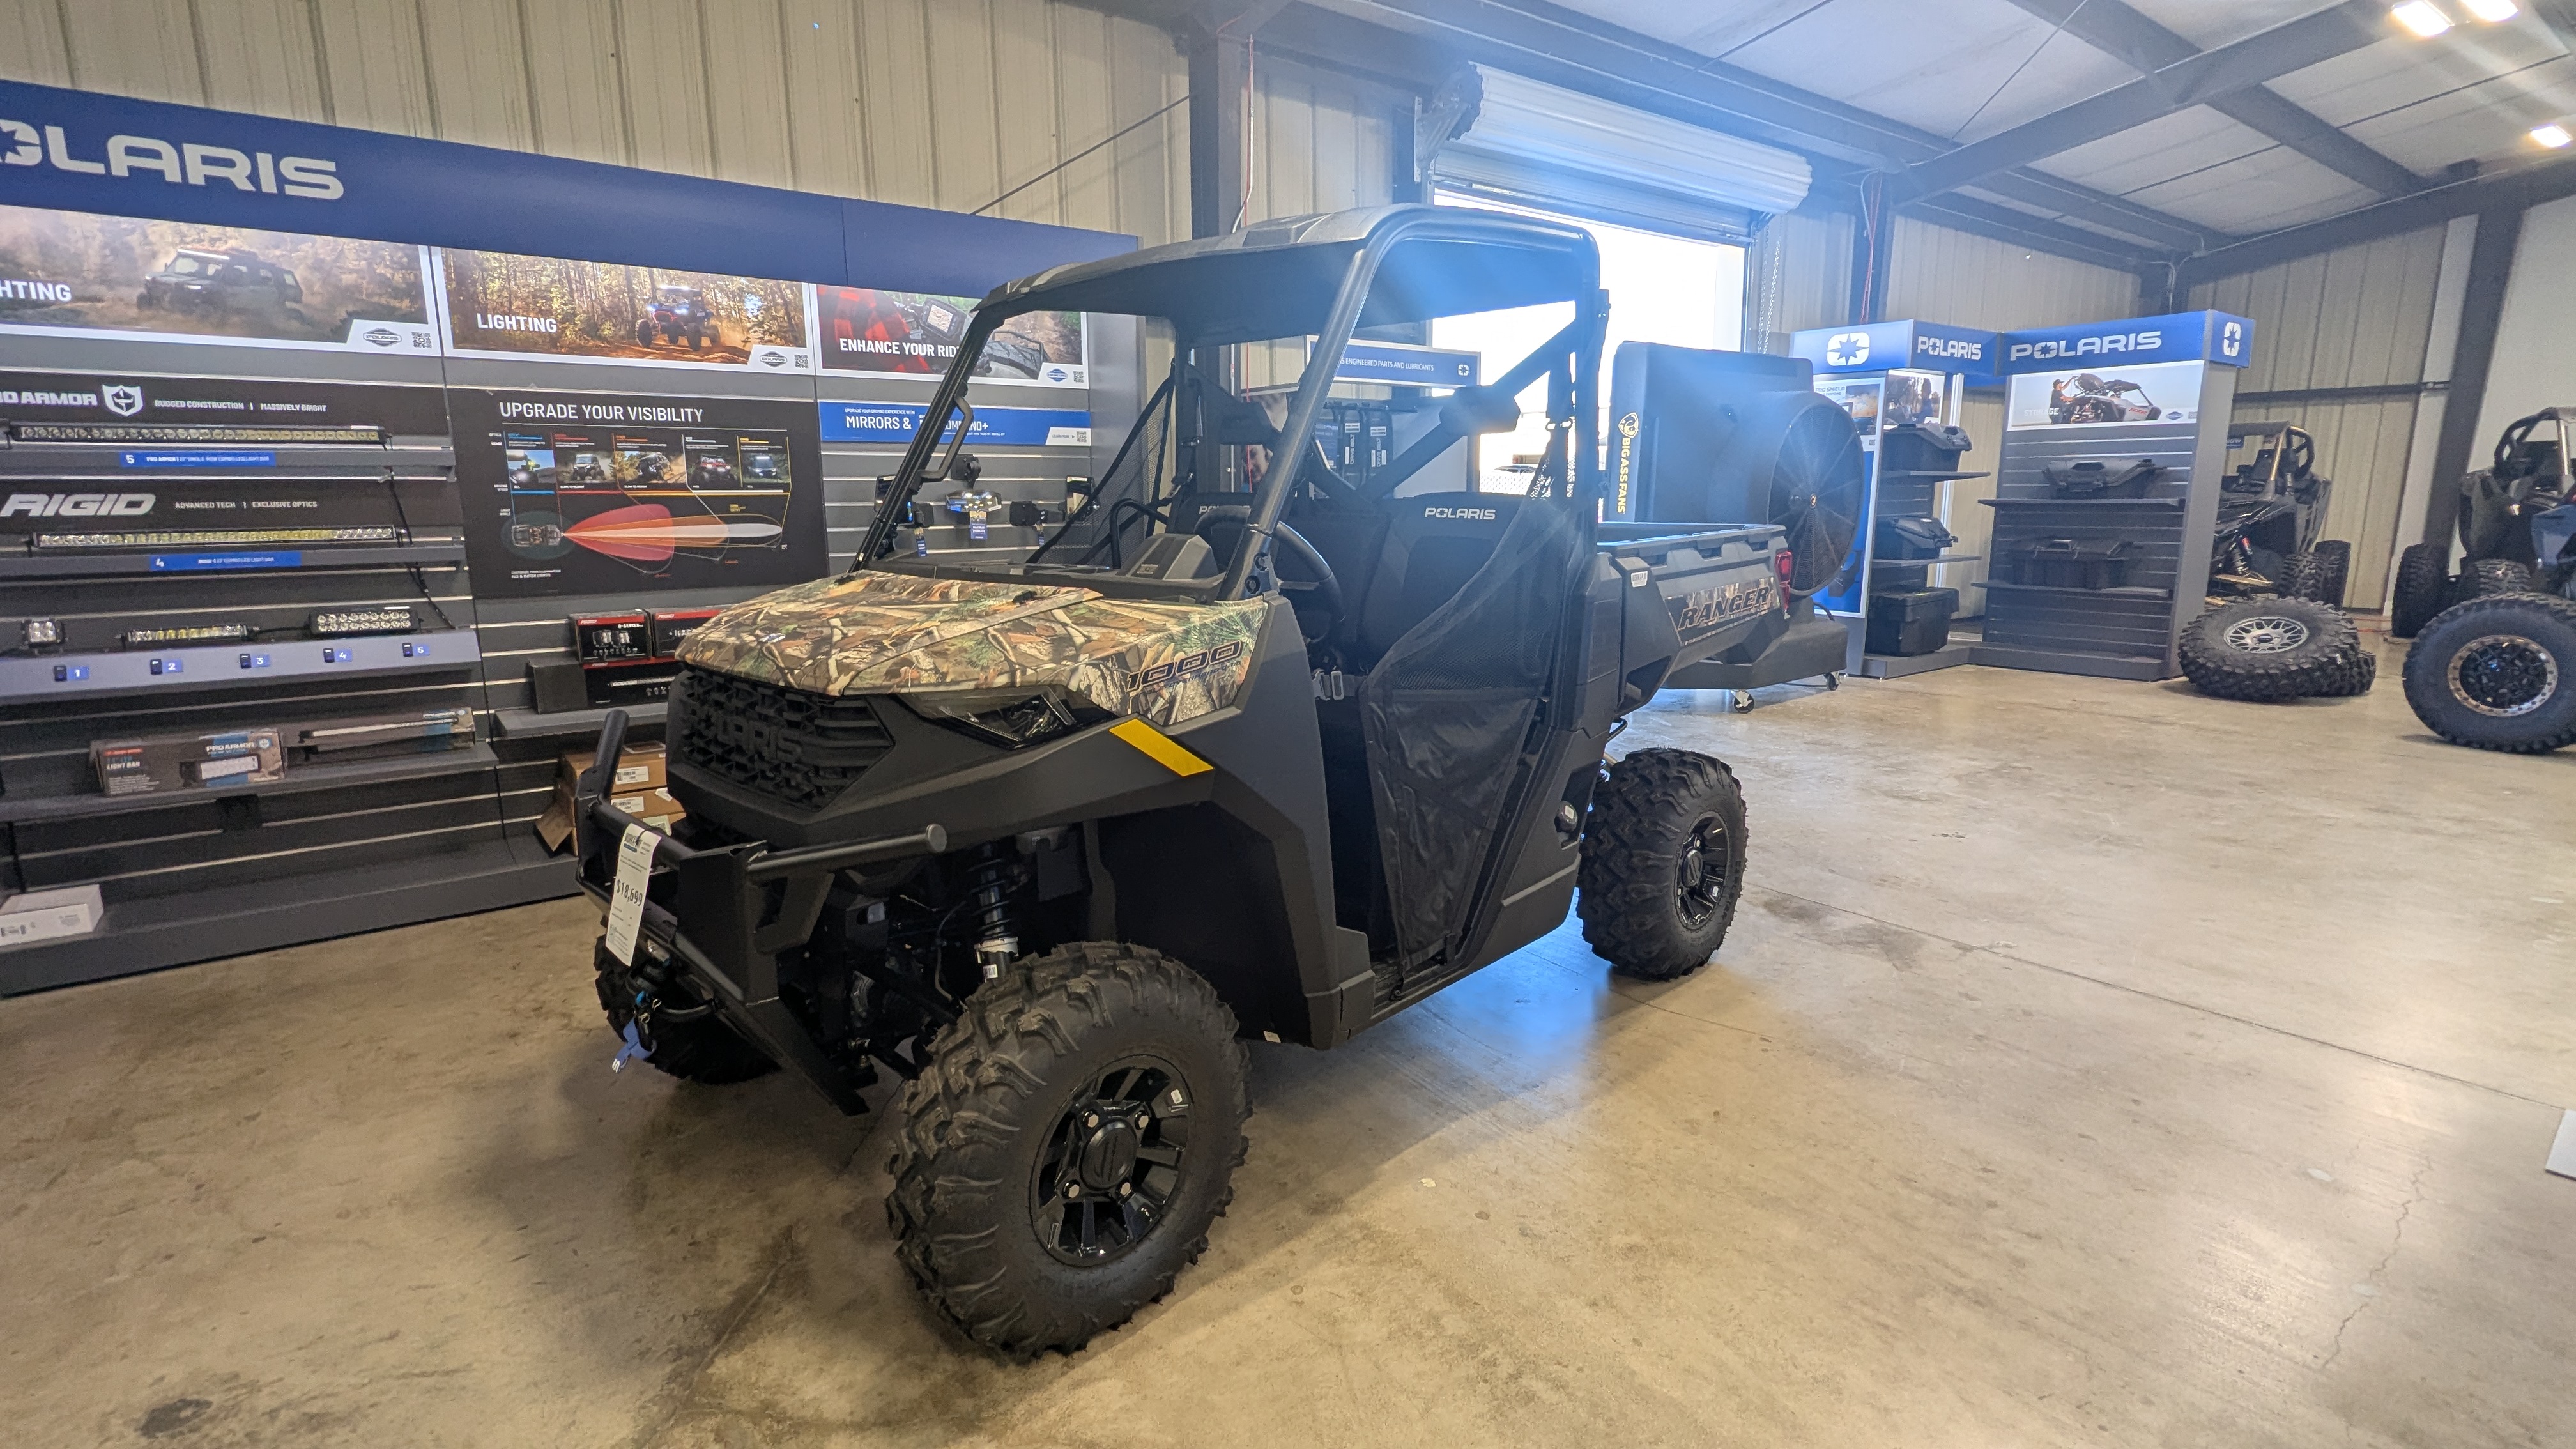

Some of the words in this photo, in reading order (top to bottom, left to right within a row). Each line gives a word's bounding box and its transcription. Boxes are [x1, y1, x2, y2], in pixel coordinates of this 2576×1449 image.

[0, 119, 344, 199] OLARIS
[0, 279, 72, 302] HTING
[477, 312, 557, 334] LIGHTING
[839, 337, 900, 355] ENHANCE
[902, 342, 935, 356] YOUR
[937, 343, 961, 359] RID
[1917, 336, 1981, 360] POLARIS
[2010, 331, 2162, 361] POLARIS
[1346, 358, 1377, 367] ENGINEERED
[1405, 363, 1434, 372] LUBRICANTS
[20, 390, 98, 406] ARMOR
[154, 399, 186, 408] RUGGED
[187, 401, 245, 410] CONSTRUCTION
[260, 402, 300, 411] MASSIVELY
[302, 404, 327, 412] BRIGHT
[499, 401, 579, 420] UPGRADE
[581, 404, 624, 422] YOUR
[628, 406, 703, 423] VISIBILITY
[846, 415, 900, 429] MIRRORS
[903, 417, 912, 430] &
[2024, 407, 2060, 417] STORAGE
[1621, 437, 1631, 457] BIG
[126, 454, 135, 464] 5
[1620, 458, 1629, 482] ASS
[1, 494, 157, 516] RIGID
[1617, 482, 1627, 514] FANS
[1424, 507, 1496, 520] POLARIS
[156, 558, 164, 567] 4
[1677, 585, 1770, 631] RANGER
[168, 662, 176, 670] 2
[256, 657, 264, 665] 3
[339, 652, 347, 660] 4
[1126, 640, 1243, 693] 1000
[224, 741, 254, 751] ARMOR
[616, 878, 643, 907] $18,699
